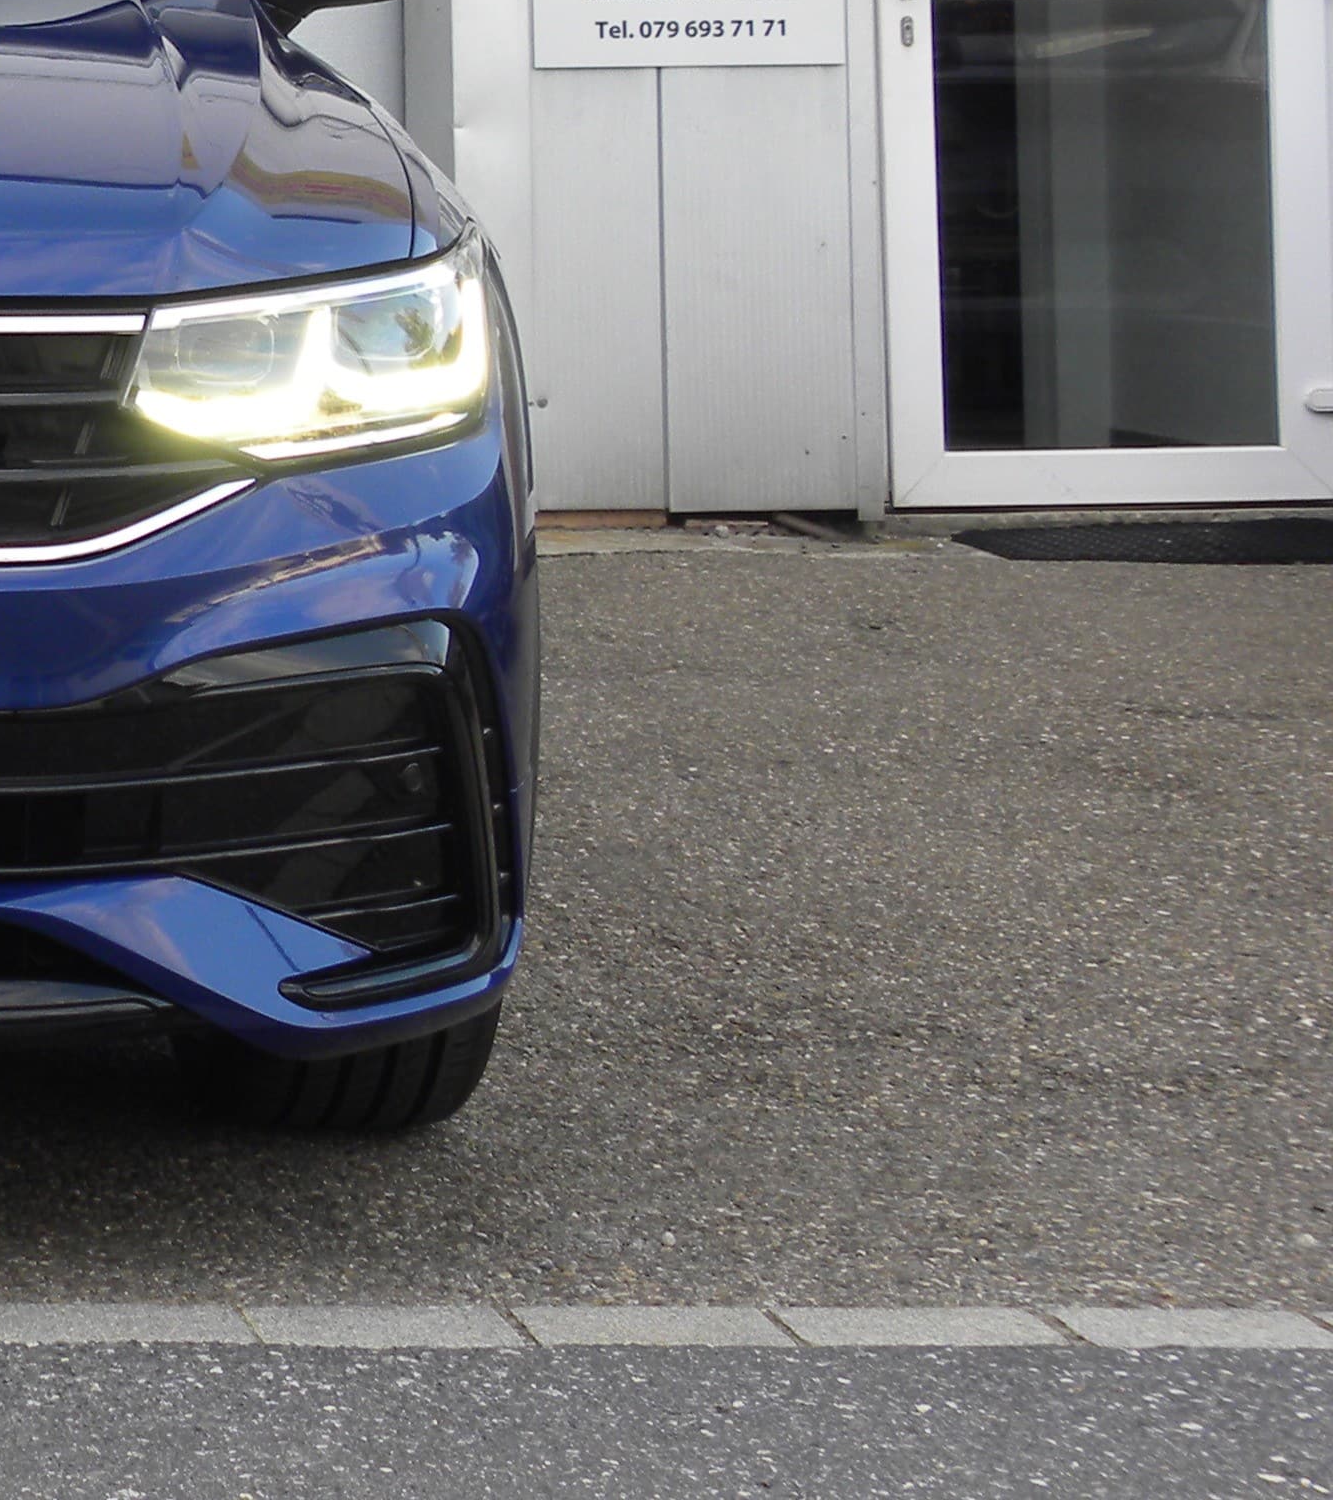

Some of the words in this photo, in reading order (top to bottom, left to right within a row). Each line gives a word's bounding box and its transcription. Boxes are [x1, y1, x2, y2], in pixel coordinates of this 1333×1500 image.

[595, 20, 634, 40] Tel.
[639, 20, 680, 39] 079
[685, 19, 725, 38] 693
[731, 19, 755, 38] 71
[762, 19, 787, 38] 71
